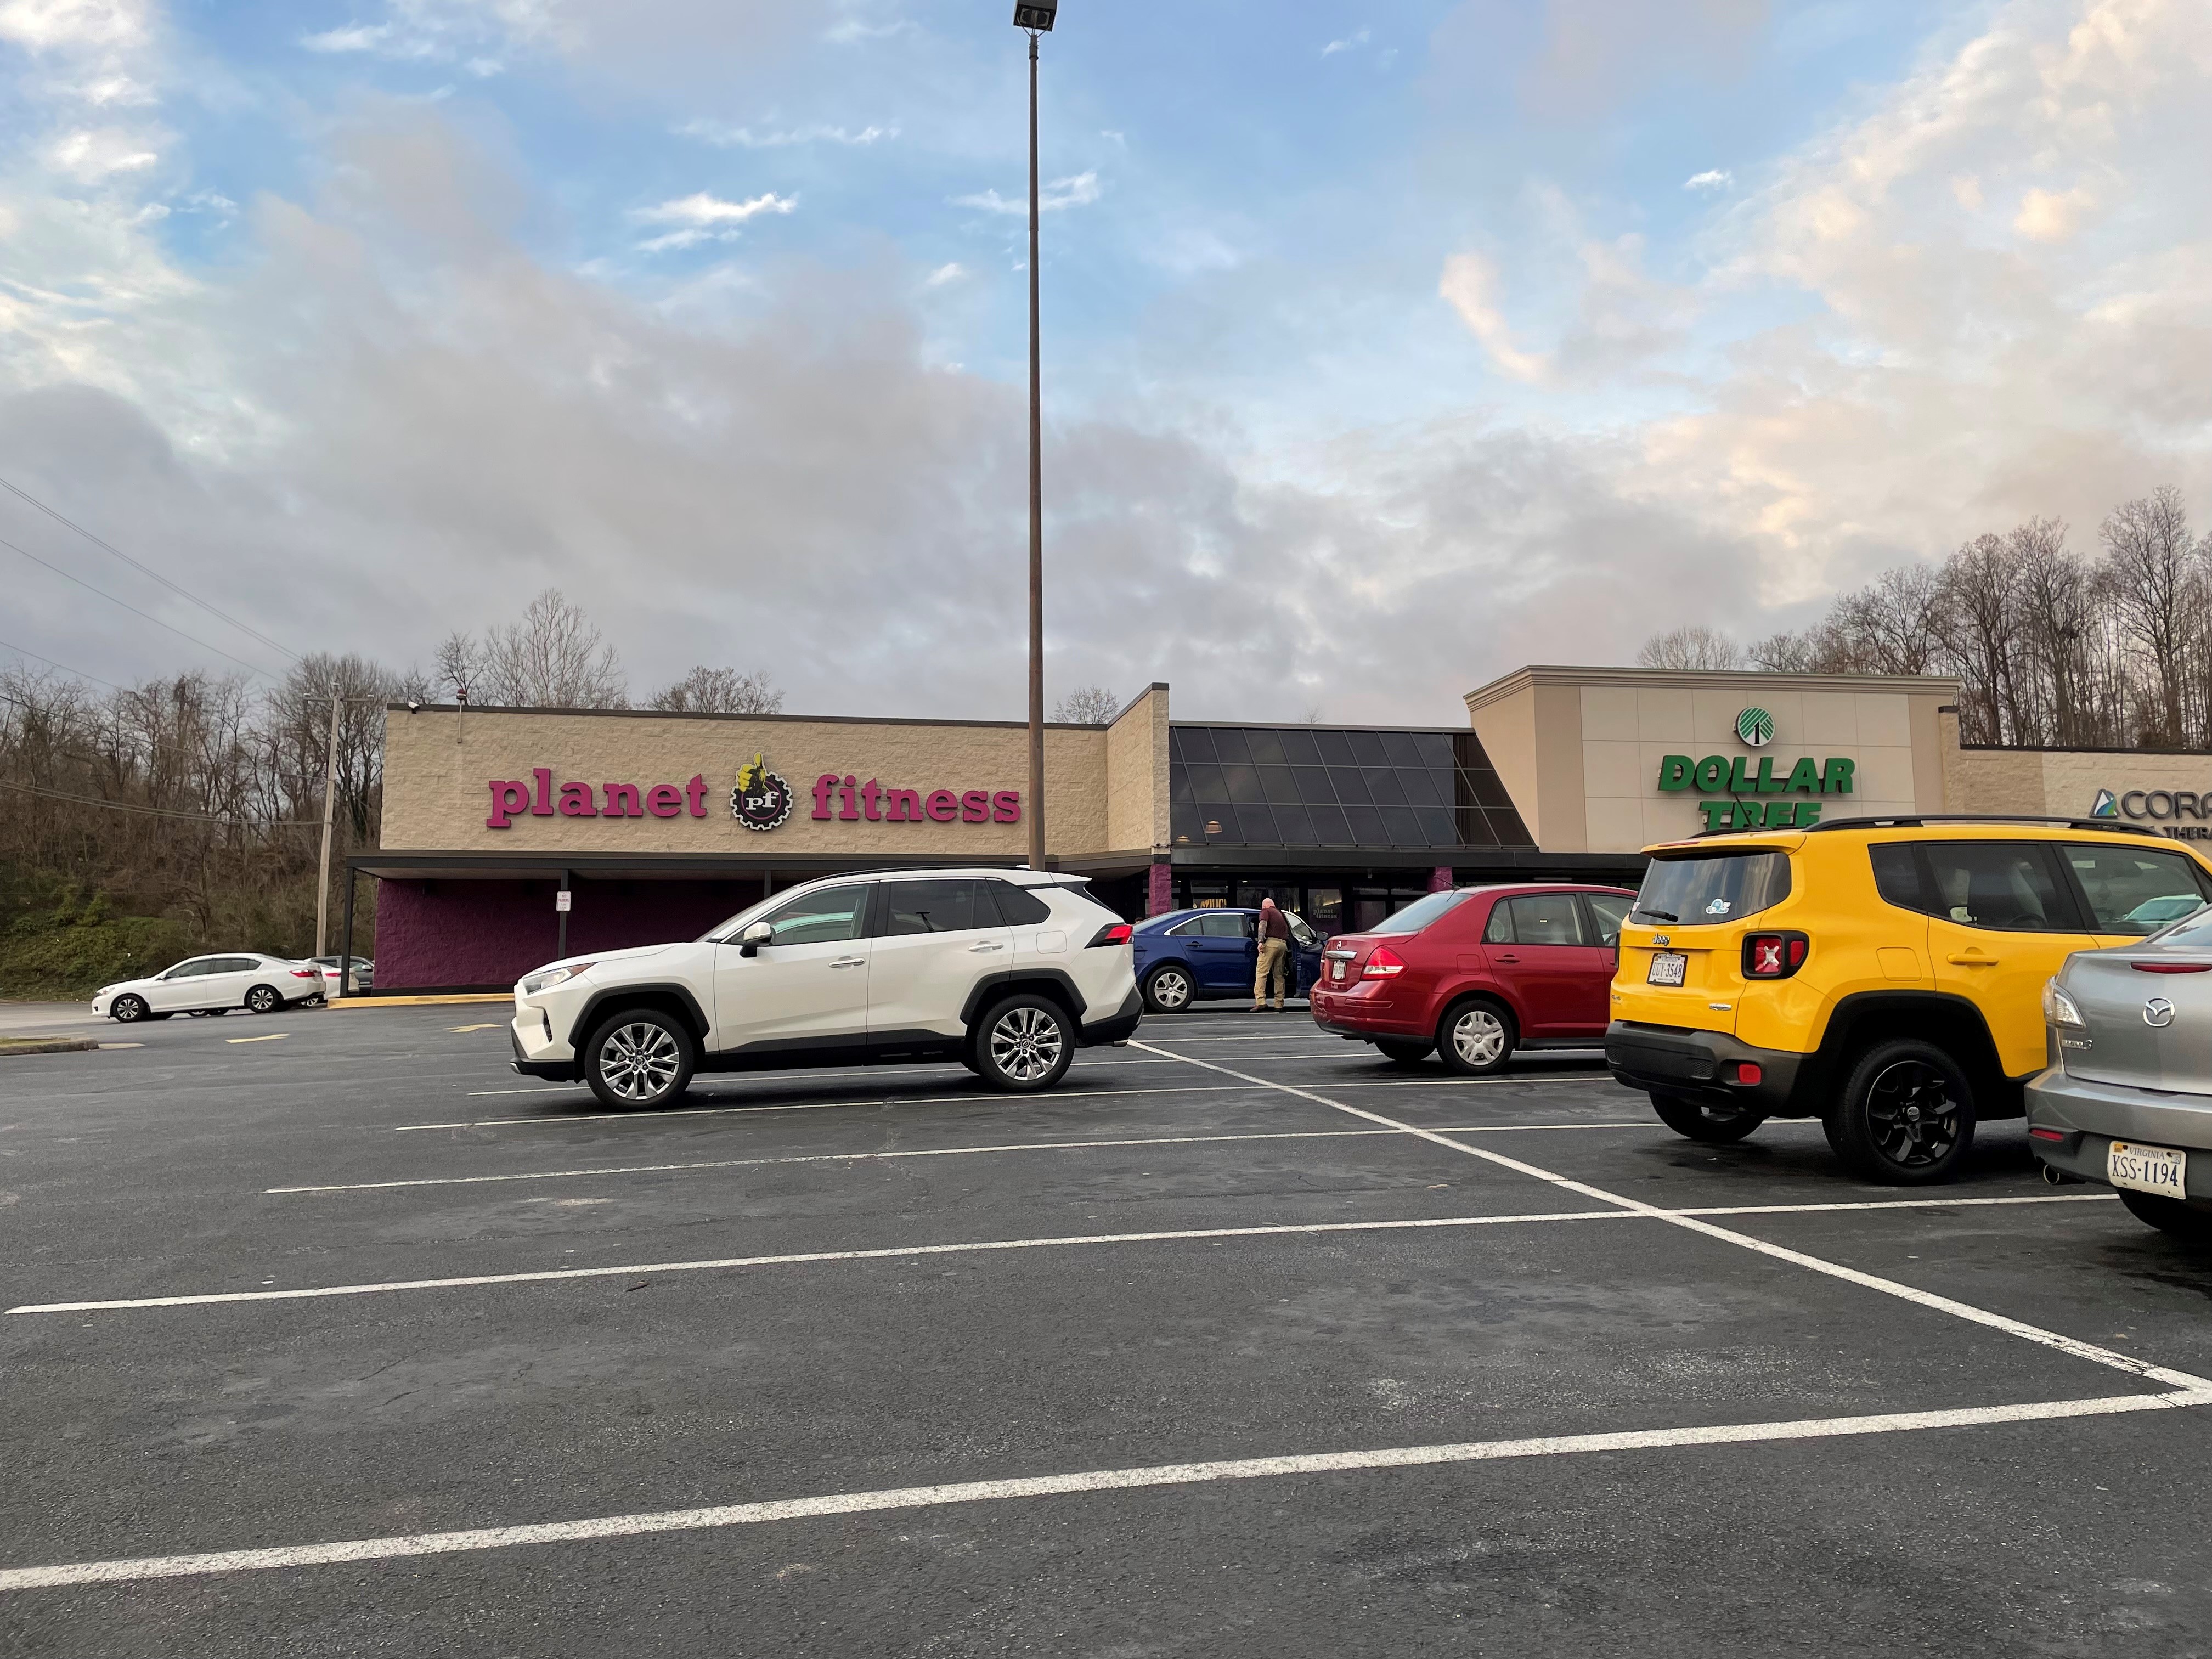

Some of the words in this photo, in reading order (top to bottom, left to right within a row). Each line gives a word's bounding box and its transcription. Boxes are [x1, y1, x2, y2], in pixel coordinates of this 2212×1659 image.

[1658, 755, 1855, 793] DOLLAR
[487, 769, 708, 827] planet
[811, 774, 1022, 822] fitness
[746, 791, 780, 810] pf
[2163, 826, 2212, 840] THER
[1652, 933, 1671, 946] Jeep
[2129, 1147, 2165, 1160] VIRGINIA
